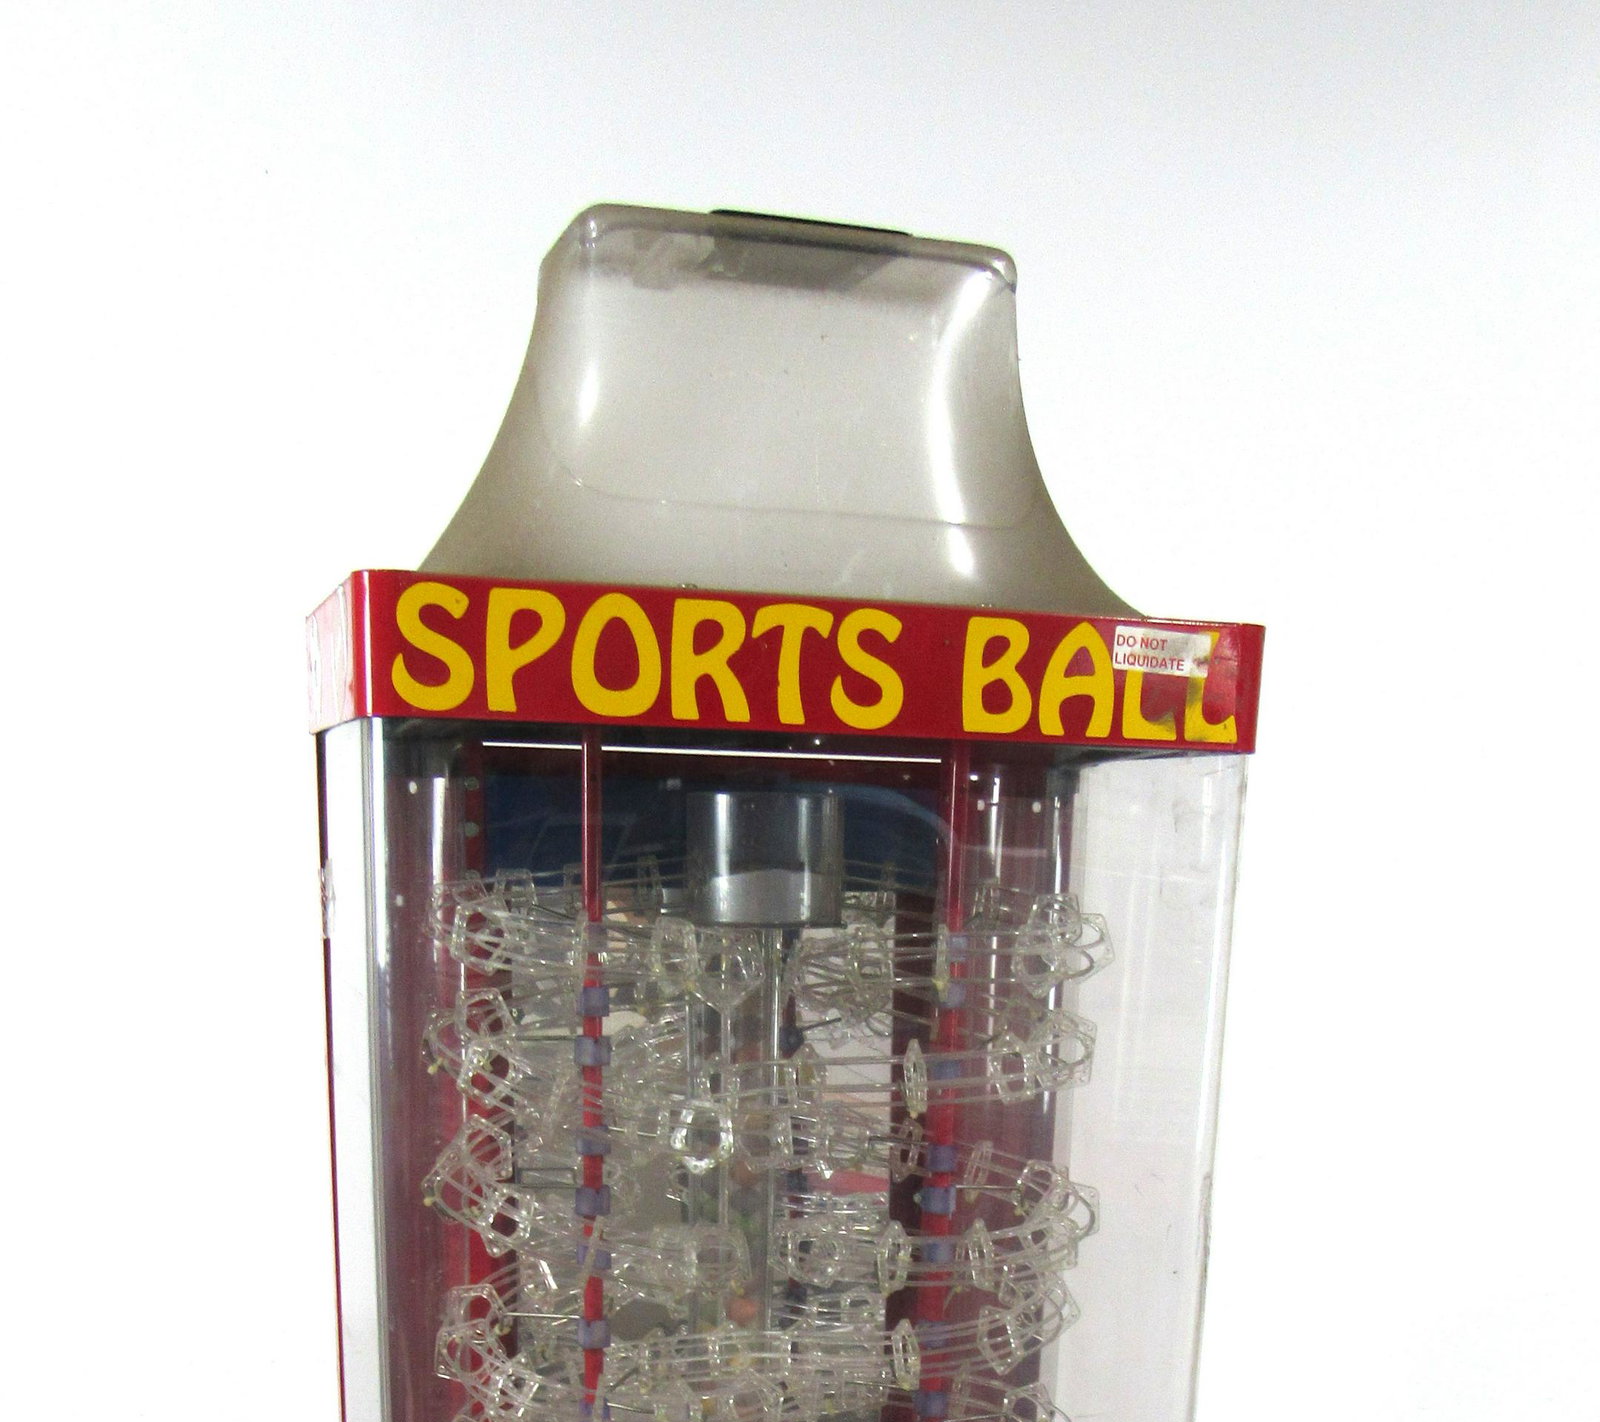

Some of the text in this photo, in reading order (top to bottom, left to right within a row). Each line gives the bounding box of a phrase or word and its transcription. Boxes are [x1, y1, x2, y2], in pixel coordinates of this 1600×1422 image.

[1116, 635, 1168, 651] DO NOT
[392, 581, 1237, 743] SPORTS BALL
[1114, 652, 1185, 671] LIQUIDATE
